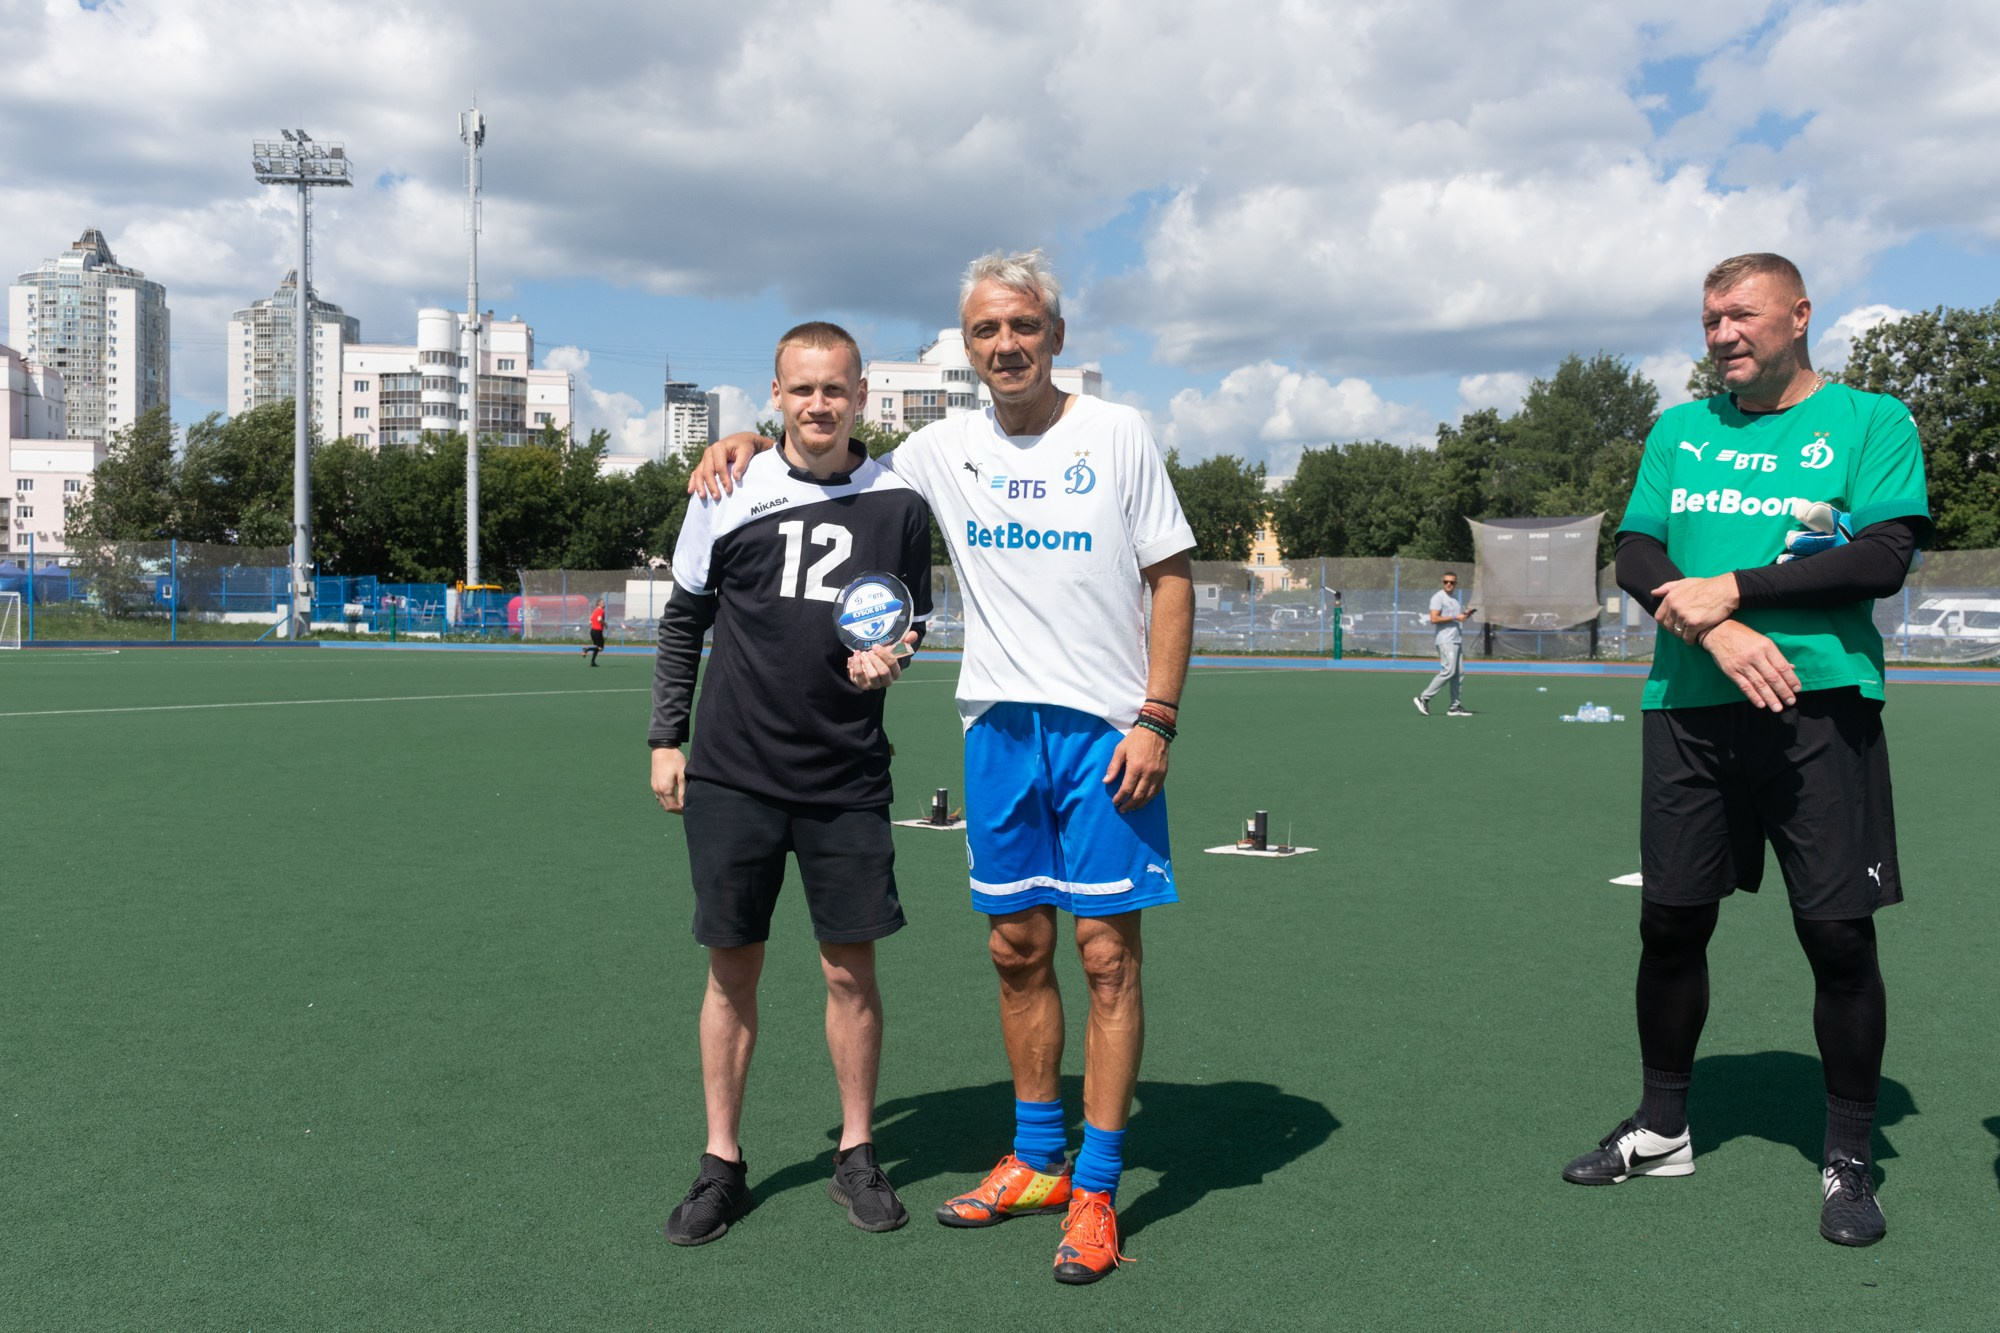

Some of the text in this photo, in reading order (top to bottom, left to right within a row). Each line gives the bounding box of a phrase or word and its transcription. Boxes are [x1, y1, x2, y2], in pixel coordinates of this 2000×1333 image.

[1733, 453, 1778, 473] ВТБ
[1007, 479, 1047, 499] ВТБ
[966, 520, 1093, 552] BetBoom
[778, 520, 853, 603] 12
[852, 608, 875, 618] КУБОК
[874, 604, 887, 612] ВТБ
